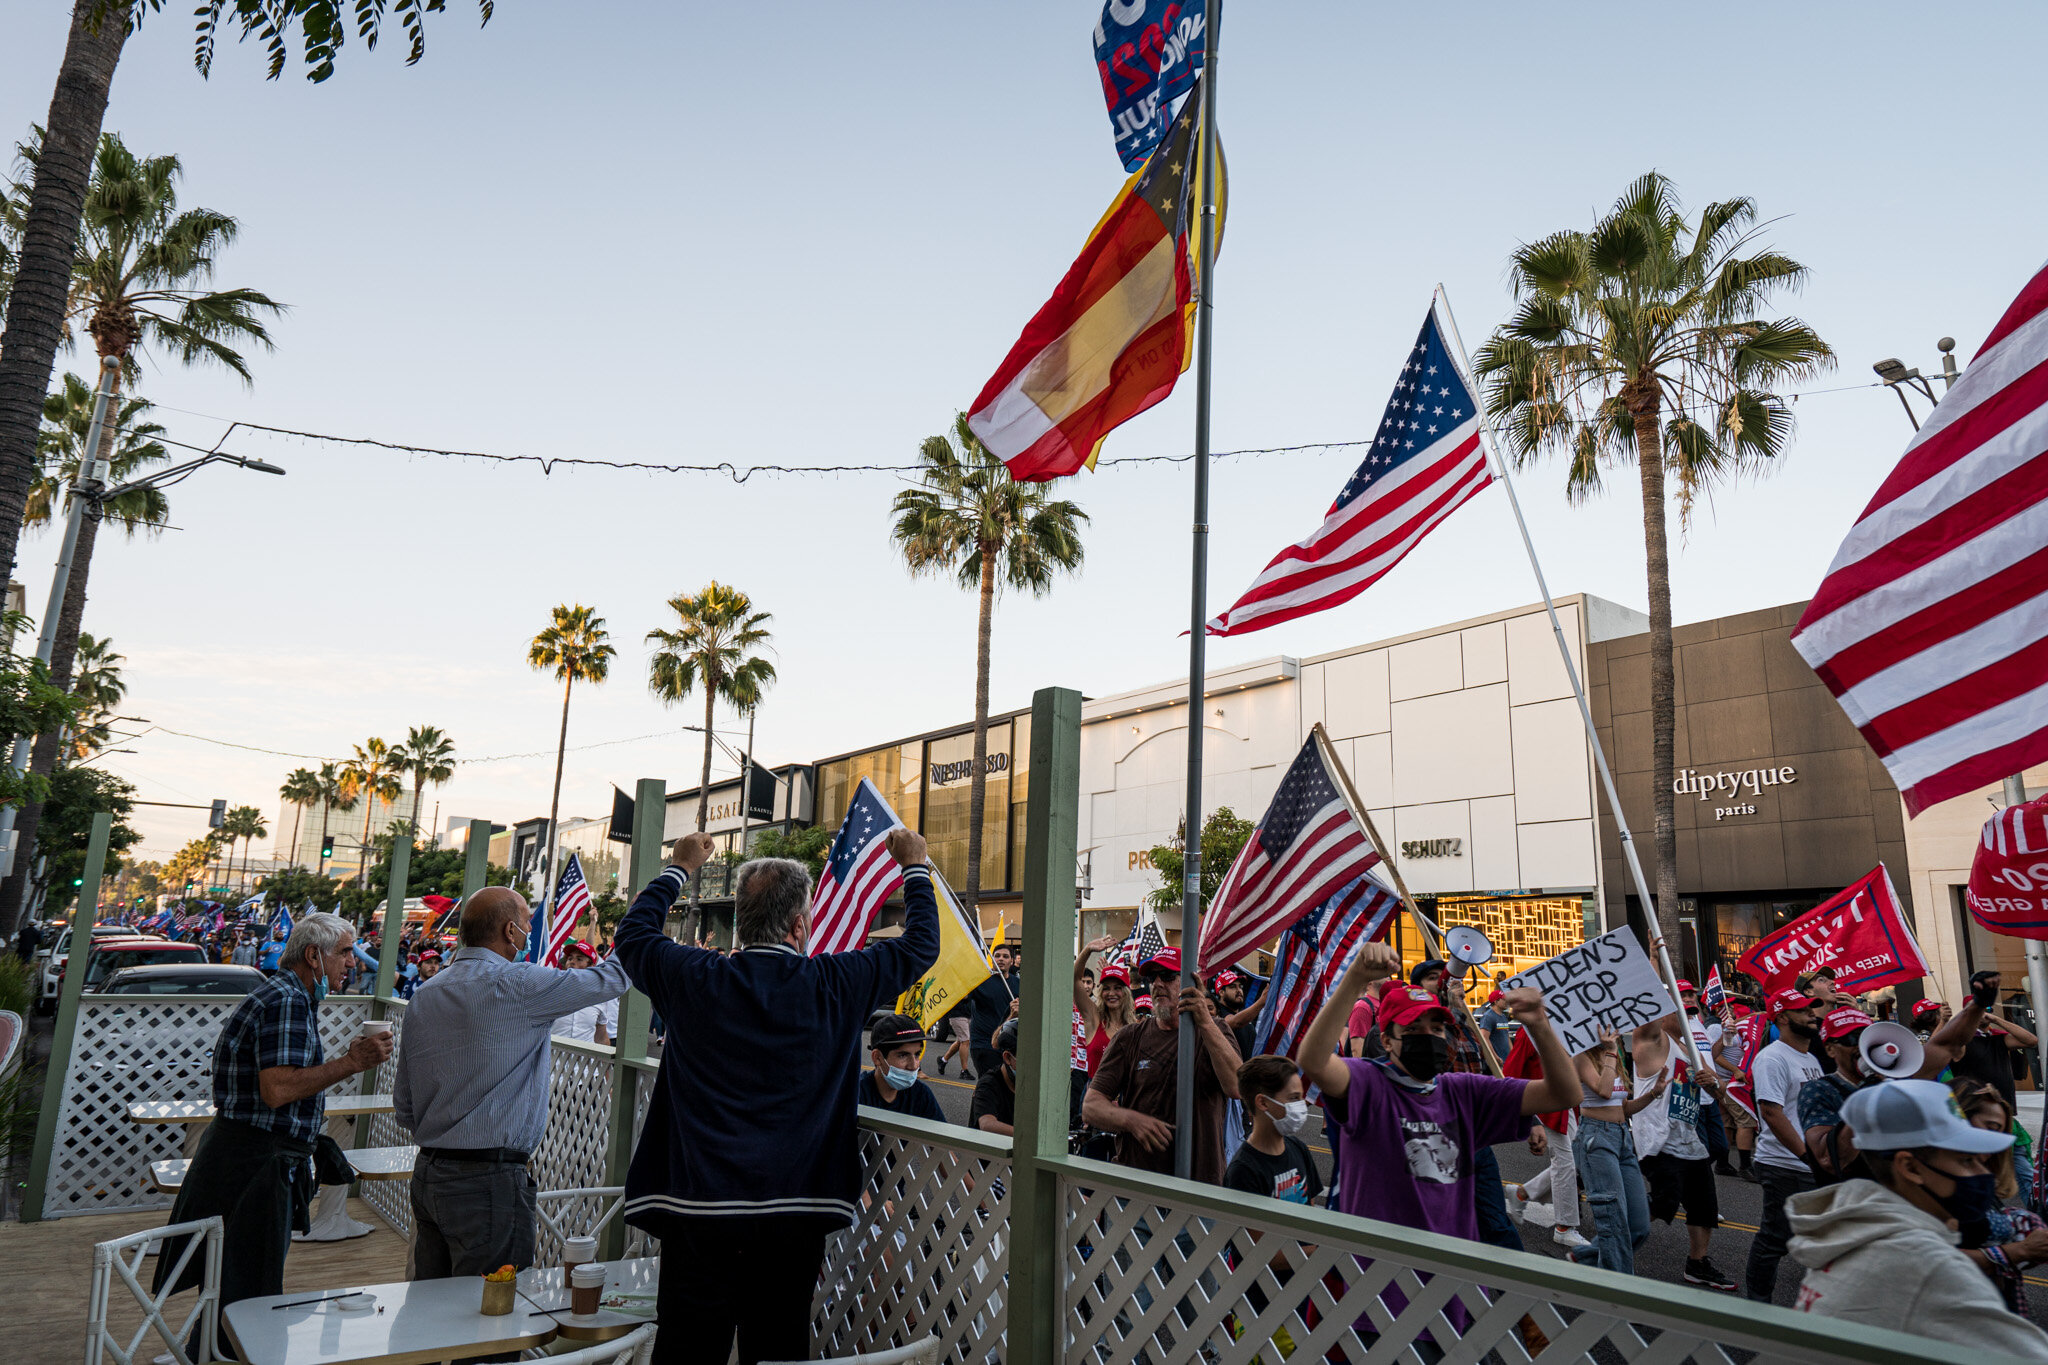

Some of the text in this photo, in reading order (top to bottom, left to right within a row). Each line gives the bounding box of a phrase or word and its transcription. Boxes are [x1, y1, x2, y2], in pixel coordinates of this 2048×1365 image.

[930, 752, 1009, 786] NESPRSO
[1673, 766, 1799, 802] diptyque
[1715, 803, 1757, 821] paris
[1401, 837, 1463, 859] SCHUTZ
[1543, 970, 1619, 1024] APTOP
[1773, 1001, 1783, 1012] 45
[1562, 992, 1662, 1054] ATTERS
